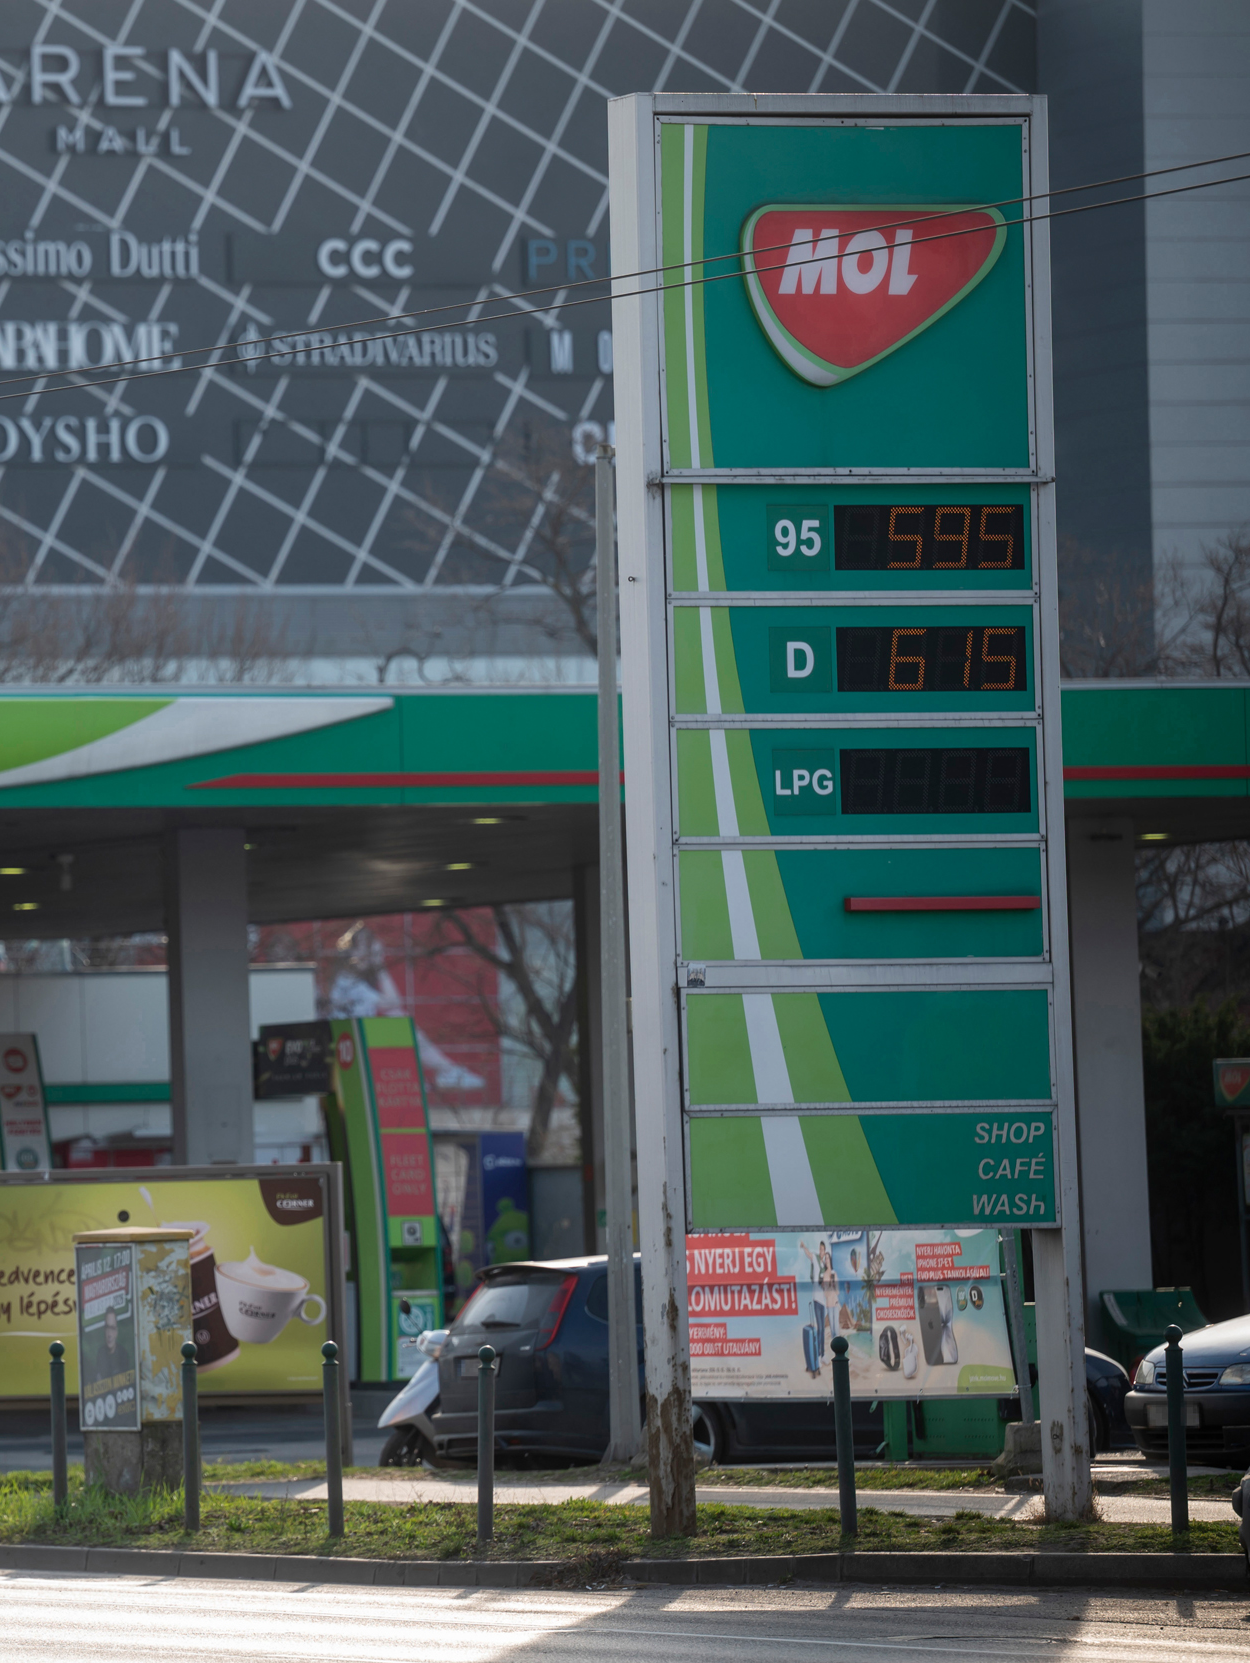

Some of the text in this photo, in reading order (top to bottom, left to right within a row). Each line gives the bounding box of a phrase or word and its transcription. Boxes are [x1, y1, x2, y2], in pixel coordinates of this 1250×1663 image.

[56, 125, 192, 157] MALL
[109, 230, 200, 280] Dutti
[317, 237, 415, 281] CCC
[778, 228, 918, 296] MOL
[270, 330, 499, 367] STRADIVARIUS
[774, 519, 822, 557] 95
[888, 507, 1015, 569] 595
[786, 641, 815, 678] D
[889, 628, 1017, 690] 615
[774, 768, 834, 796] LPG
[974, 1122, 1045, 1144] SHOP
[389, 1155, 424, 1167] FLEET
[391, 1169, 425, 1181] CARD
[978, 1152, 1046, 1180] CAFÉ
[392, 1182, 427, 1195] ONLY
[276, 1199, 315, 1209] CORNER
[972, 1193, 1045, 1216] WASH
[694, 1248, 739, 1275] NYERJ
[744, 1246, 773, 1273] EGY
[917, 1258, 937, 1268] IPHONE
